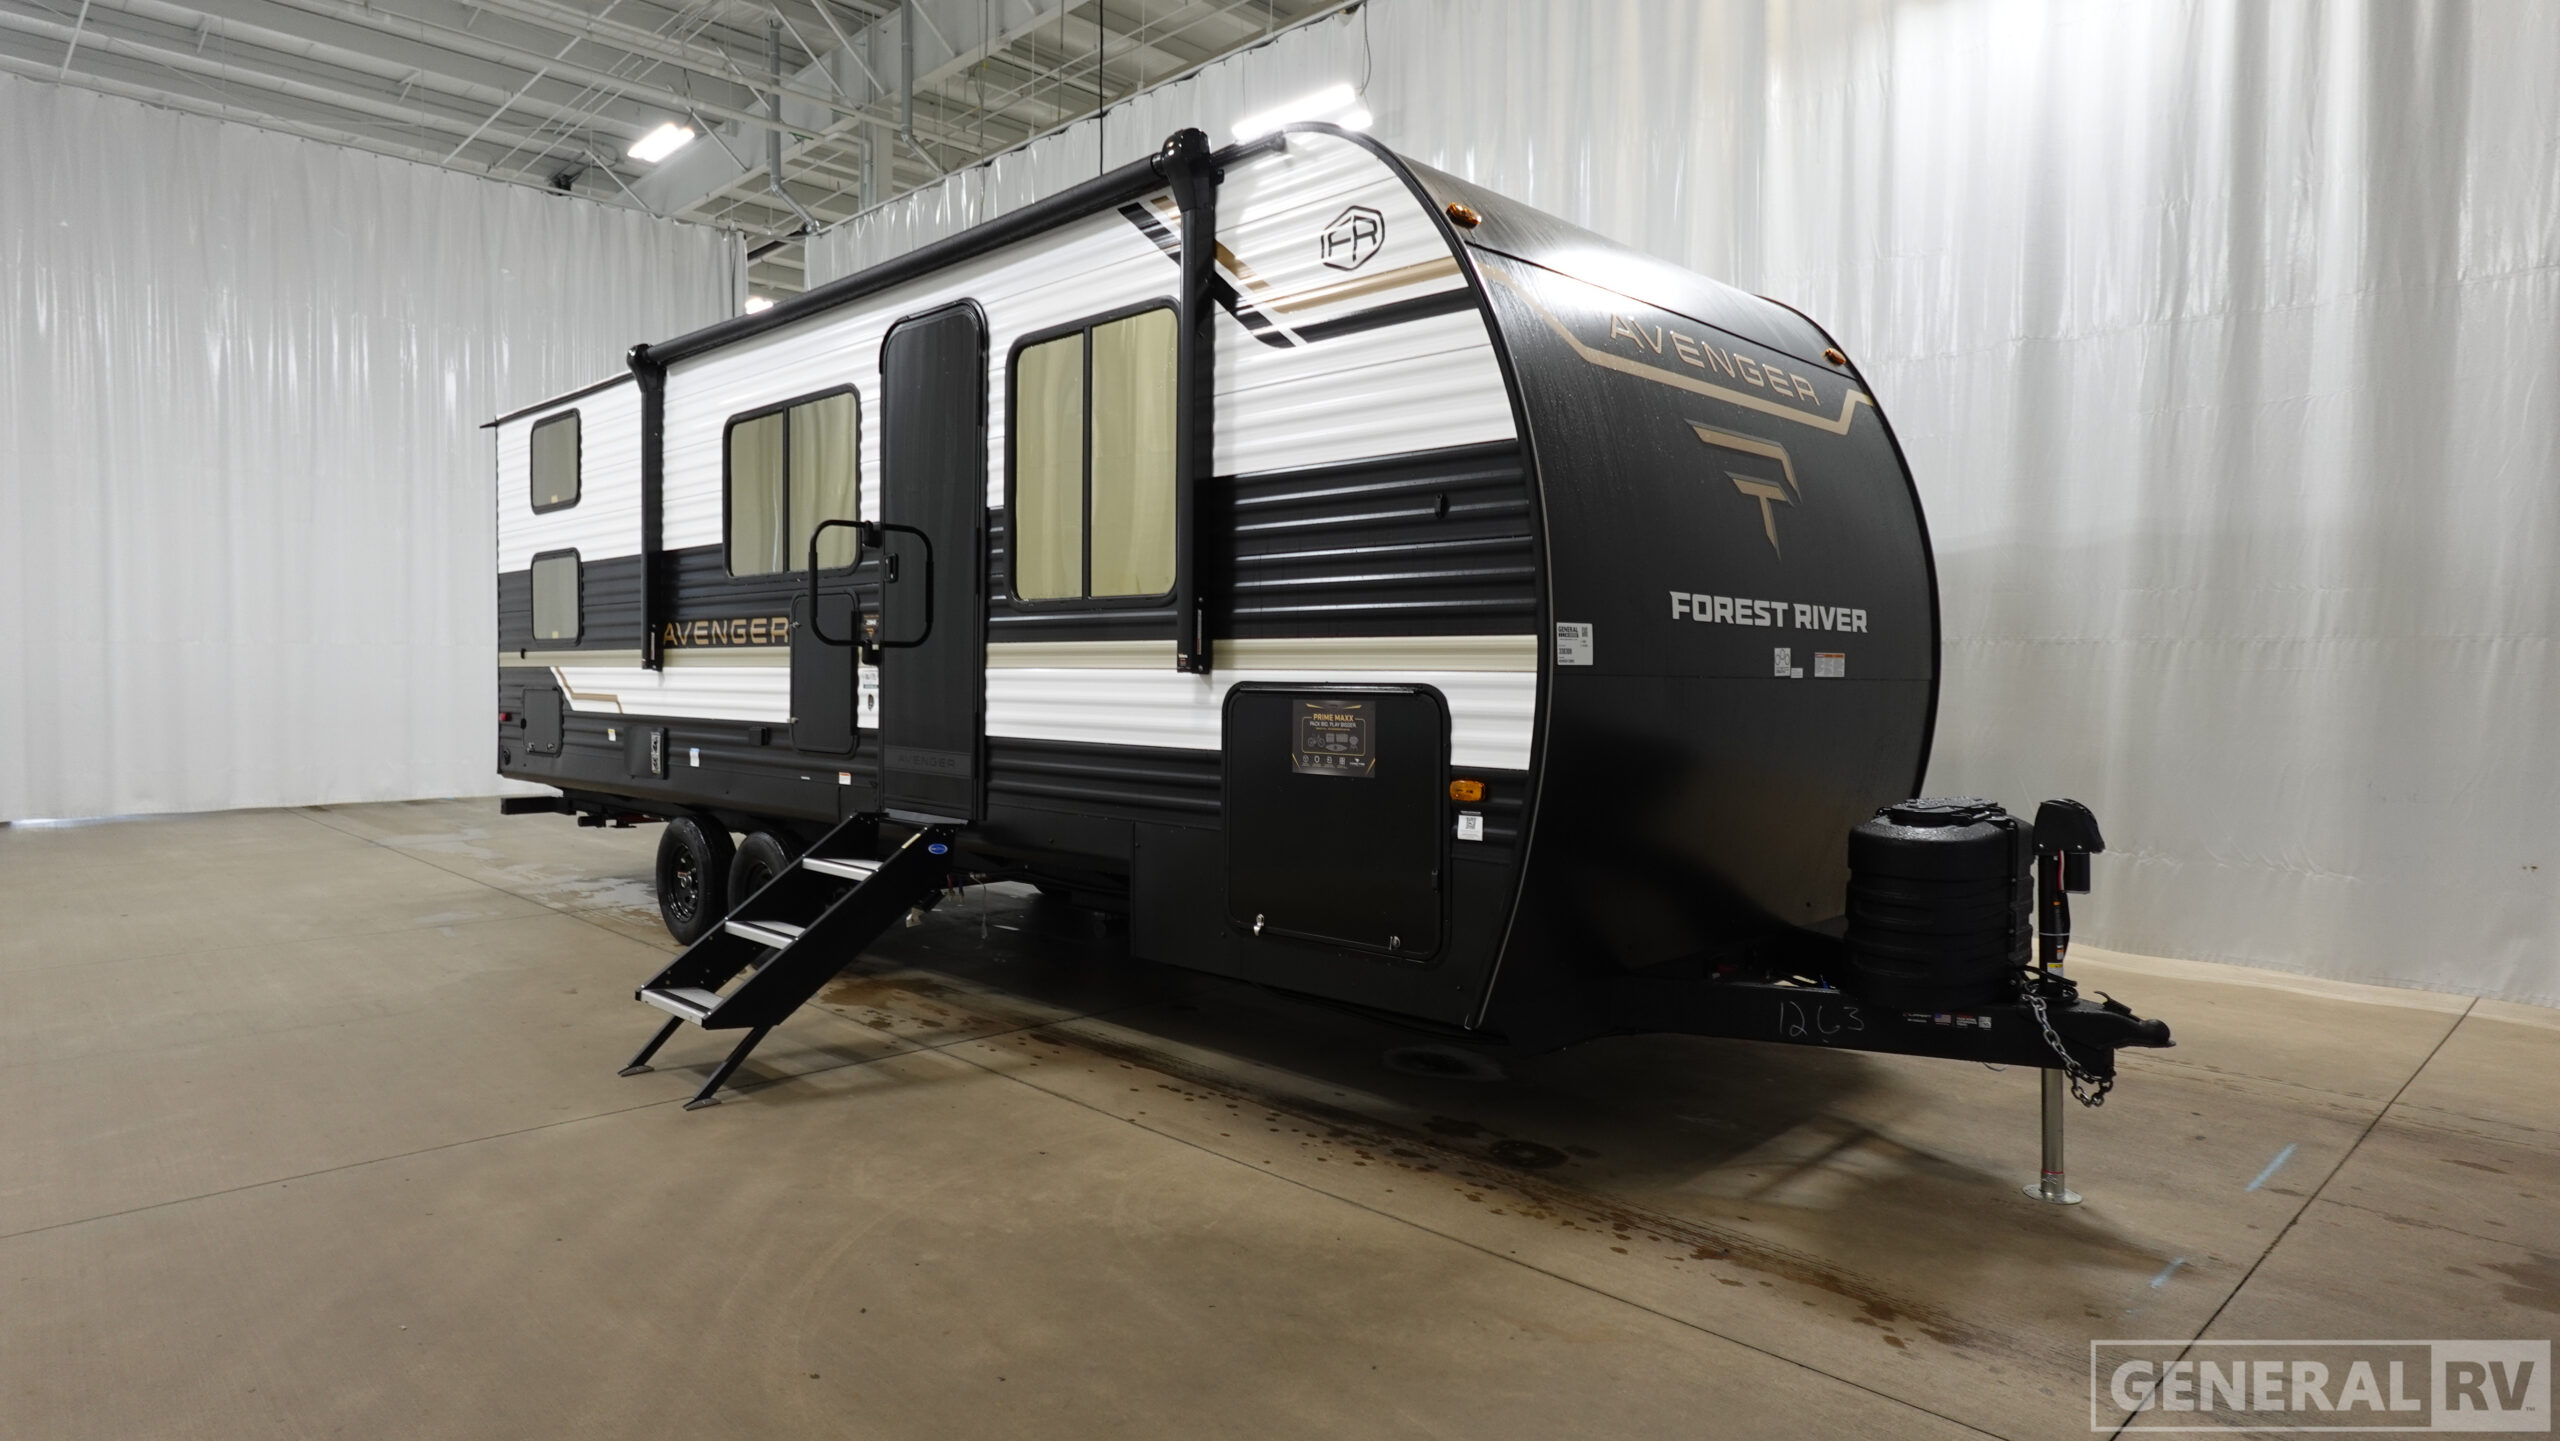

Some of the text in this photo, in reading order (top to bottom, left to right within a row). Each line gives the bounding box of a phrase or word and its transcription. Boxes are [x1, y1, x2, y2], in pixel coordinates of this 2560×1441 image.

[1609, 312, 1820, 406] AVENGER
[1669, 591, 1868, 633] FOREST RIVER
[663, 617, 790, 646] AVENGER
[1313, 713, 1354, 722] PRIME MAXX
[897, 754, 956, 768] AVENGER
